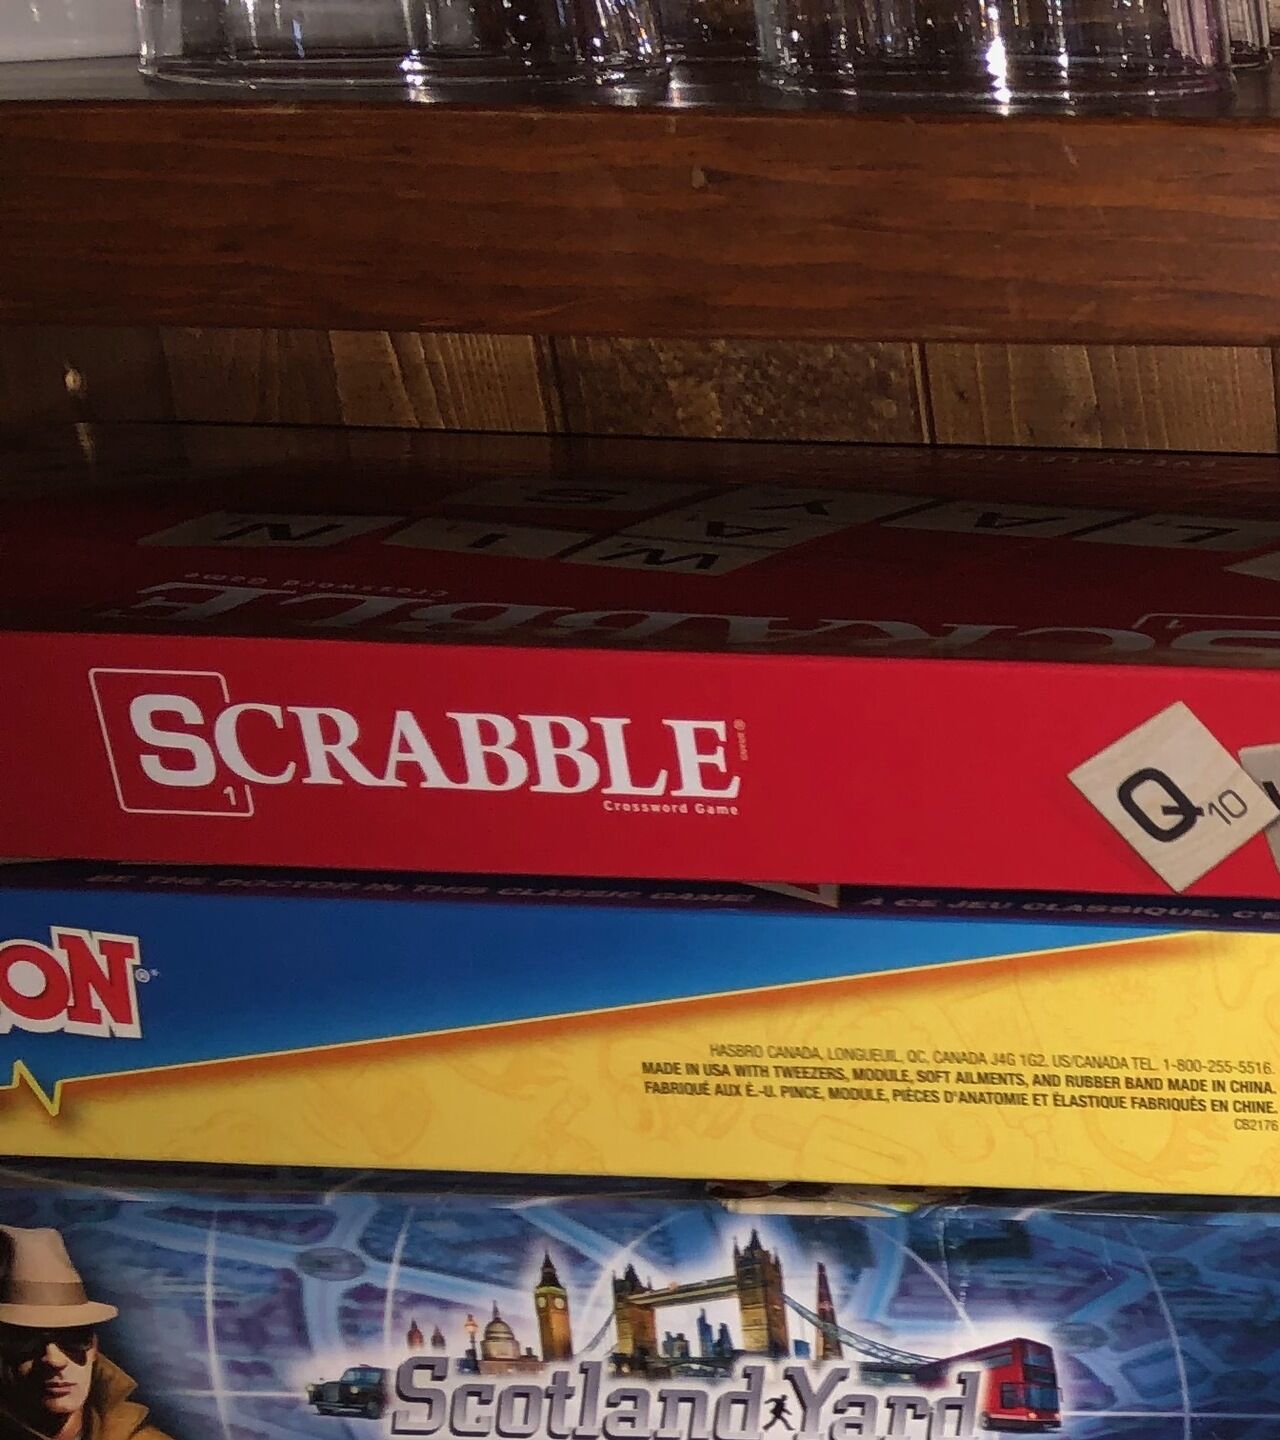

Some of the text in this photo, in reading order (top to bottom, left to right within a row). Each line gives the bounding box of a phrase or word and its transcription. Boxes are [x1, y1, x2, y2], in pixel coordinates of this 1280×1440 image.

[127, 692, 741, 798] SCRABBLE
[603, 798, 740, 818] Crossword Game
[1116, 767, 1204, 844] Q
[217, 876, 642, 901] DOCTOR CLASSIC
[710, 1044, 1128, 1071] HASBRO CANADA, LONGUEUIL, CANADA J4G US/CANADA
[641, 1062, 1278, 1095] MADE IN USA WITH TWEEZERS, MODULE, SOFT AILMENTS, AND RUBBER BAND MADE IN CHINA.
[644, 1079, 1279, 1115] FABRIQUÉ AUX PINCE, MODULE, PIÈCES D'ANATOMIE ET ÉLASTIQUE FABRIQUÉS EN CHINE.
